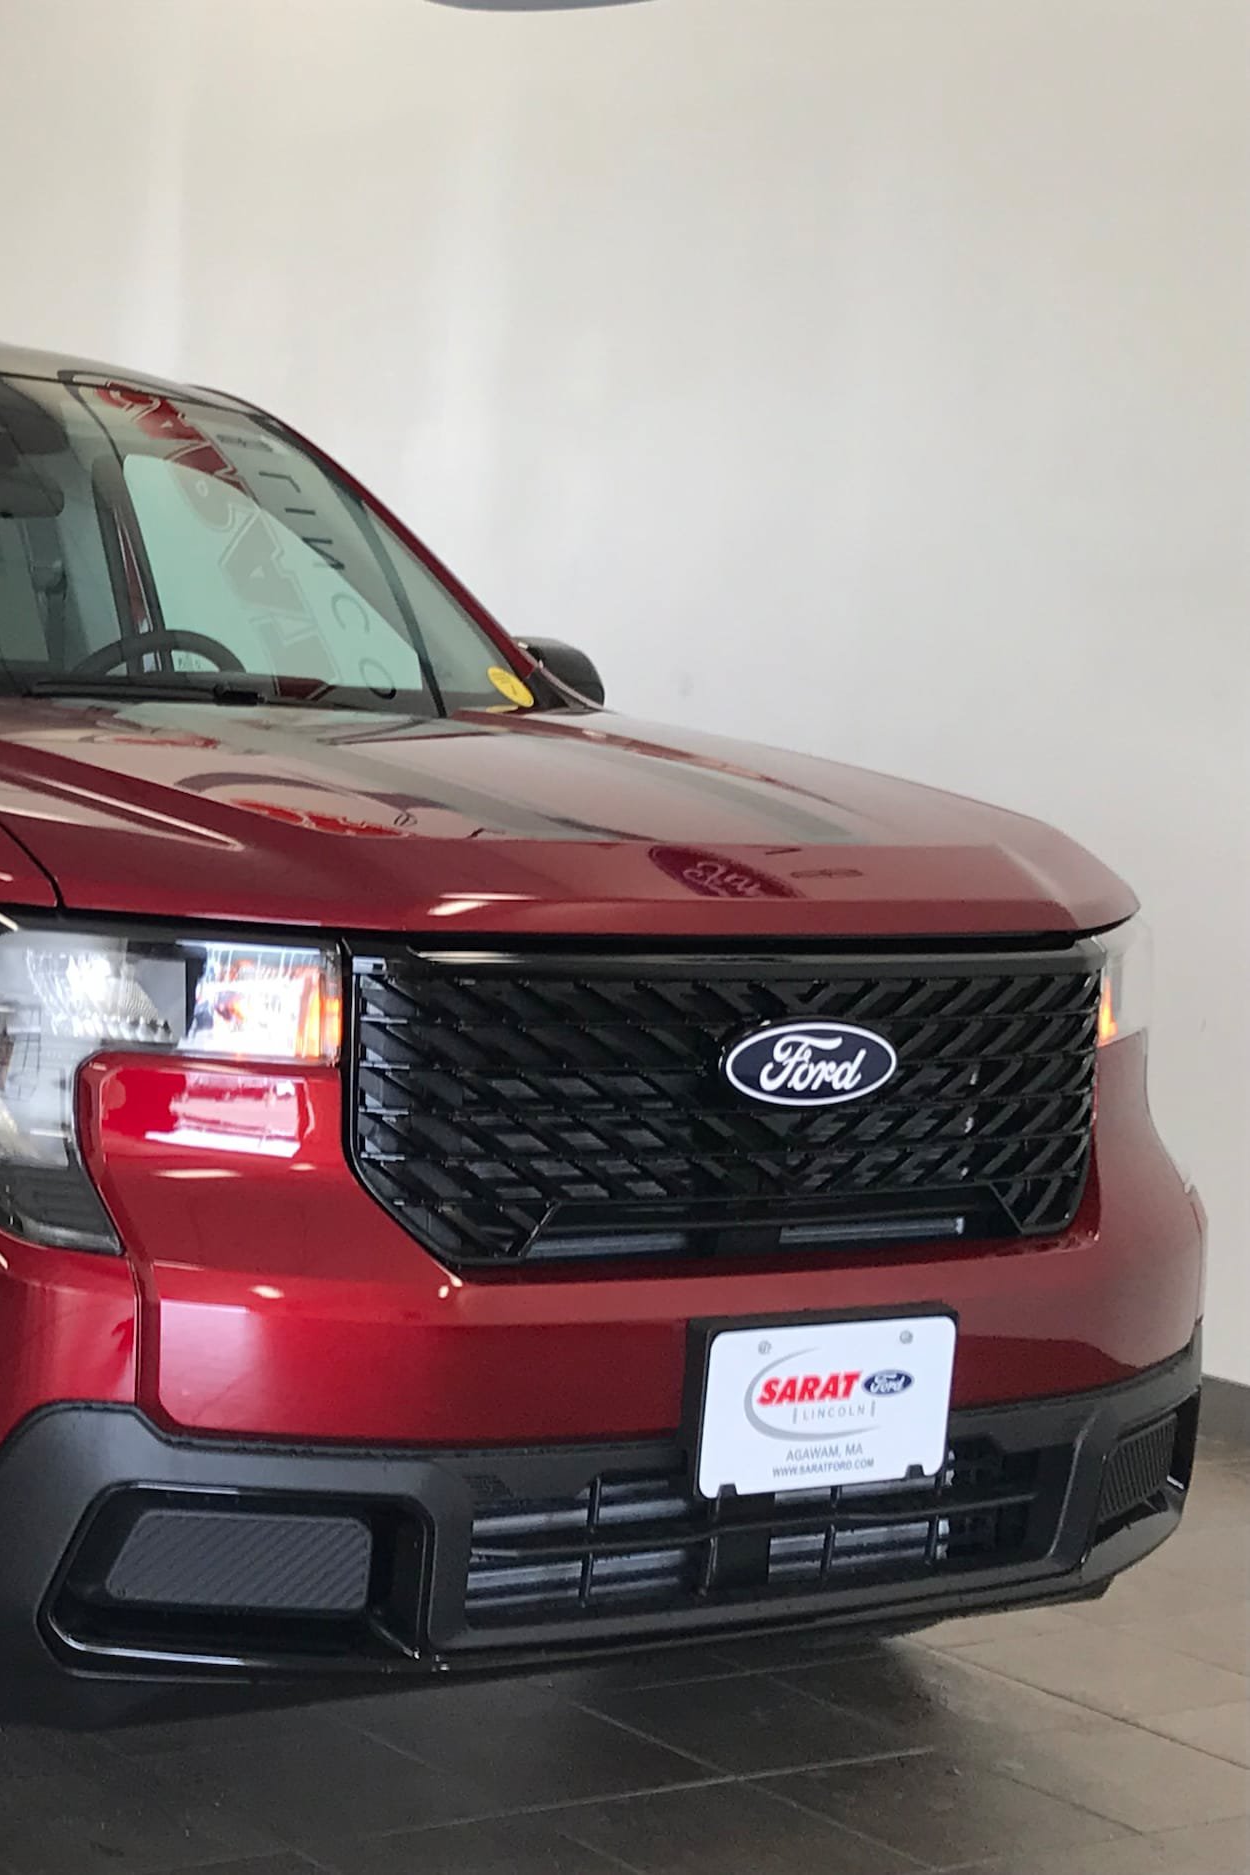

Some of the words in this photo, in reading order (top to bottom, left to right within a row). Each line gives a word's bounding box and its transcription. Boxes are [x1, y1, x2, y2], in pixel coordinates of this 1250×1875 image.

[759, 1035, 867, 1091] Ford
[757, 1372, 862, 1406] SARAT
[870, 1374, 906, 1393] Ford
[803, 1406, 867, 1421] LINCOLN
[786, 1448, 842, 1464] AGAWAM,
[846, 1445, 864, 1458] MA
[772, 1459, 875, 1478] WWW.SARATFORD.COM
